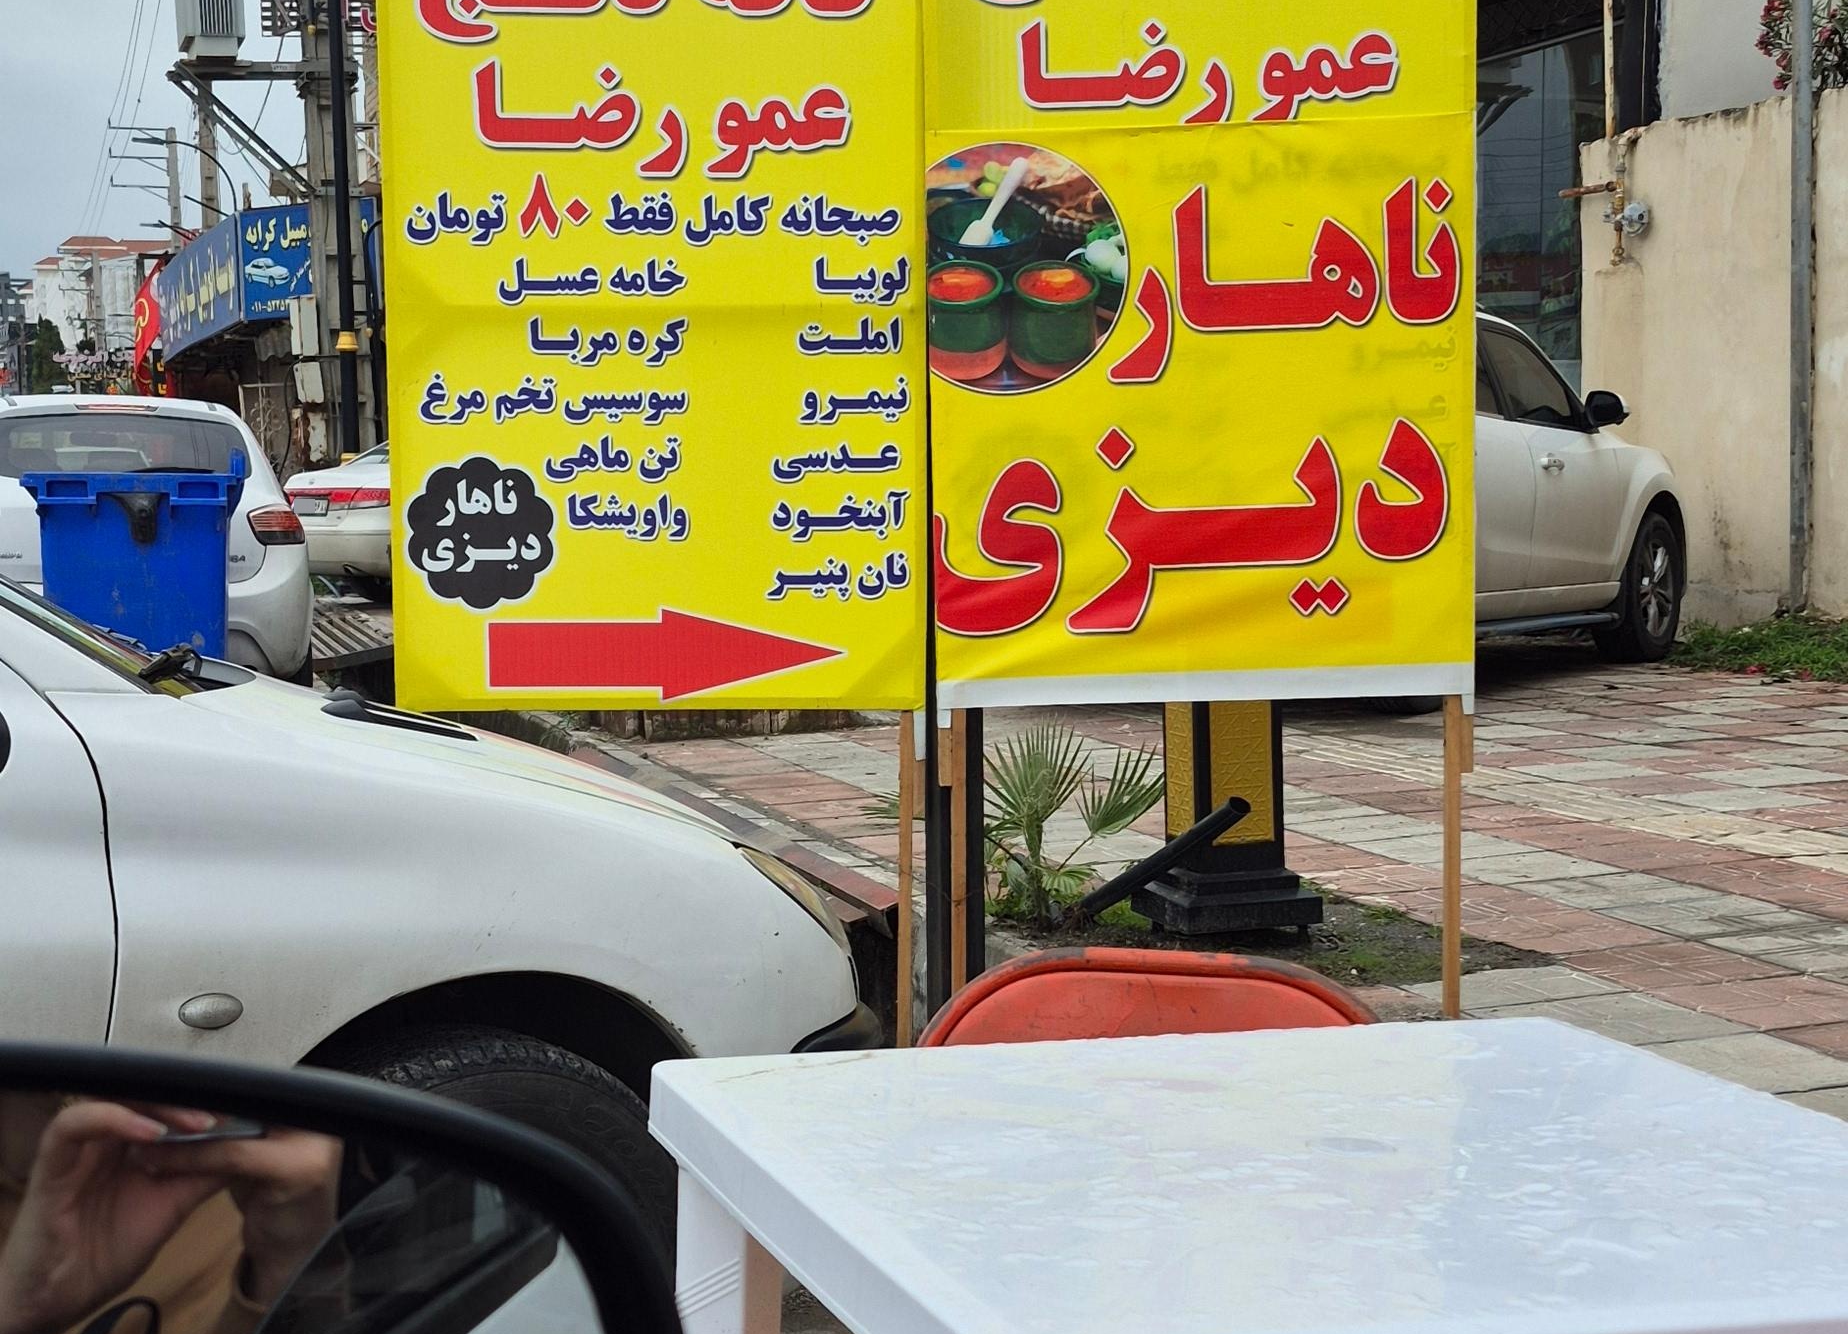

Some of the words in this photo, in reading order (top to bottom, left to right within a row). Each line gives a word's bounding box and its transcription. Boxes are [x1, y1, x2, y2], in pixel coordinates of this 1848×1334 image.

[1020, 23, 1229, 127] رضا
[1256, 34, 1395, 124] عمو
[475, 62, 686, 176] رضا
[708, 87, 848, 175] عمو
[405, 193, 507, 245] تومان
[519, 177, 589, 236] ۸۰
[605, 192, 677, 234] فقط
[684, 195, 772, 246] کامل
[780, 196, 902, 246] صبحانه
[245, 217, 277, 251] کرایه
[498, 259, 601, 305] عسل
[608, 260, 687, 295] خامه
[814, 257, 910, 305] لوبیا
[1108, 176, 1461, 383] ناهار
[529, 319, 620, 366] مربا
[626, 320, 688, 364] کره
[797, 318, 903, 355] املت
[419, 375, 488, 424] مرغ
[494, 377, 557, 423] تخم
[563, 390, 689, 425] سوسیس
[800, 375, 911, 424] نیمرو
[544, 437, 632, 482] ماهی
[638, 437, 681, 482] تن
[772, 437, 901, 483] عدسی
[435, 478, 521, 529] ناهار
[566, 494, 690, 540] واویشکا
[771, 491, 905, 541] آبنخود
[420, 530, 544, 574] دیزی
[931, 421, 1448, 636] دیزی
[768, 556, 851, 600] پنیر
[857, 553, 910, 599] نان
